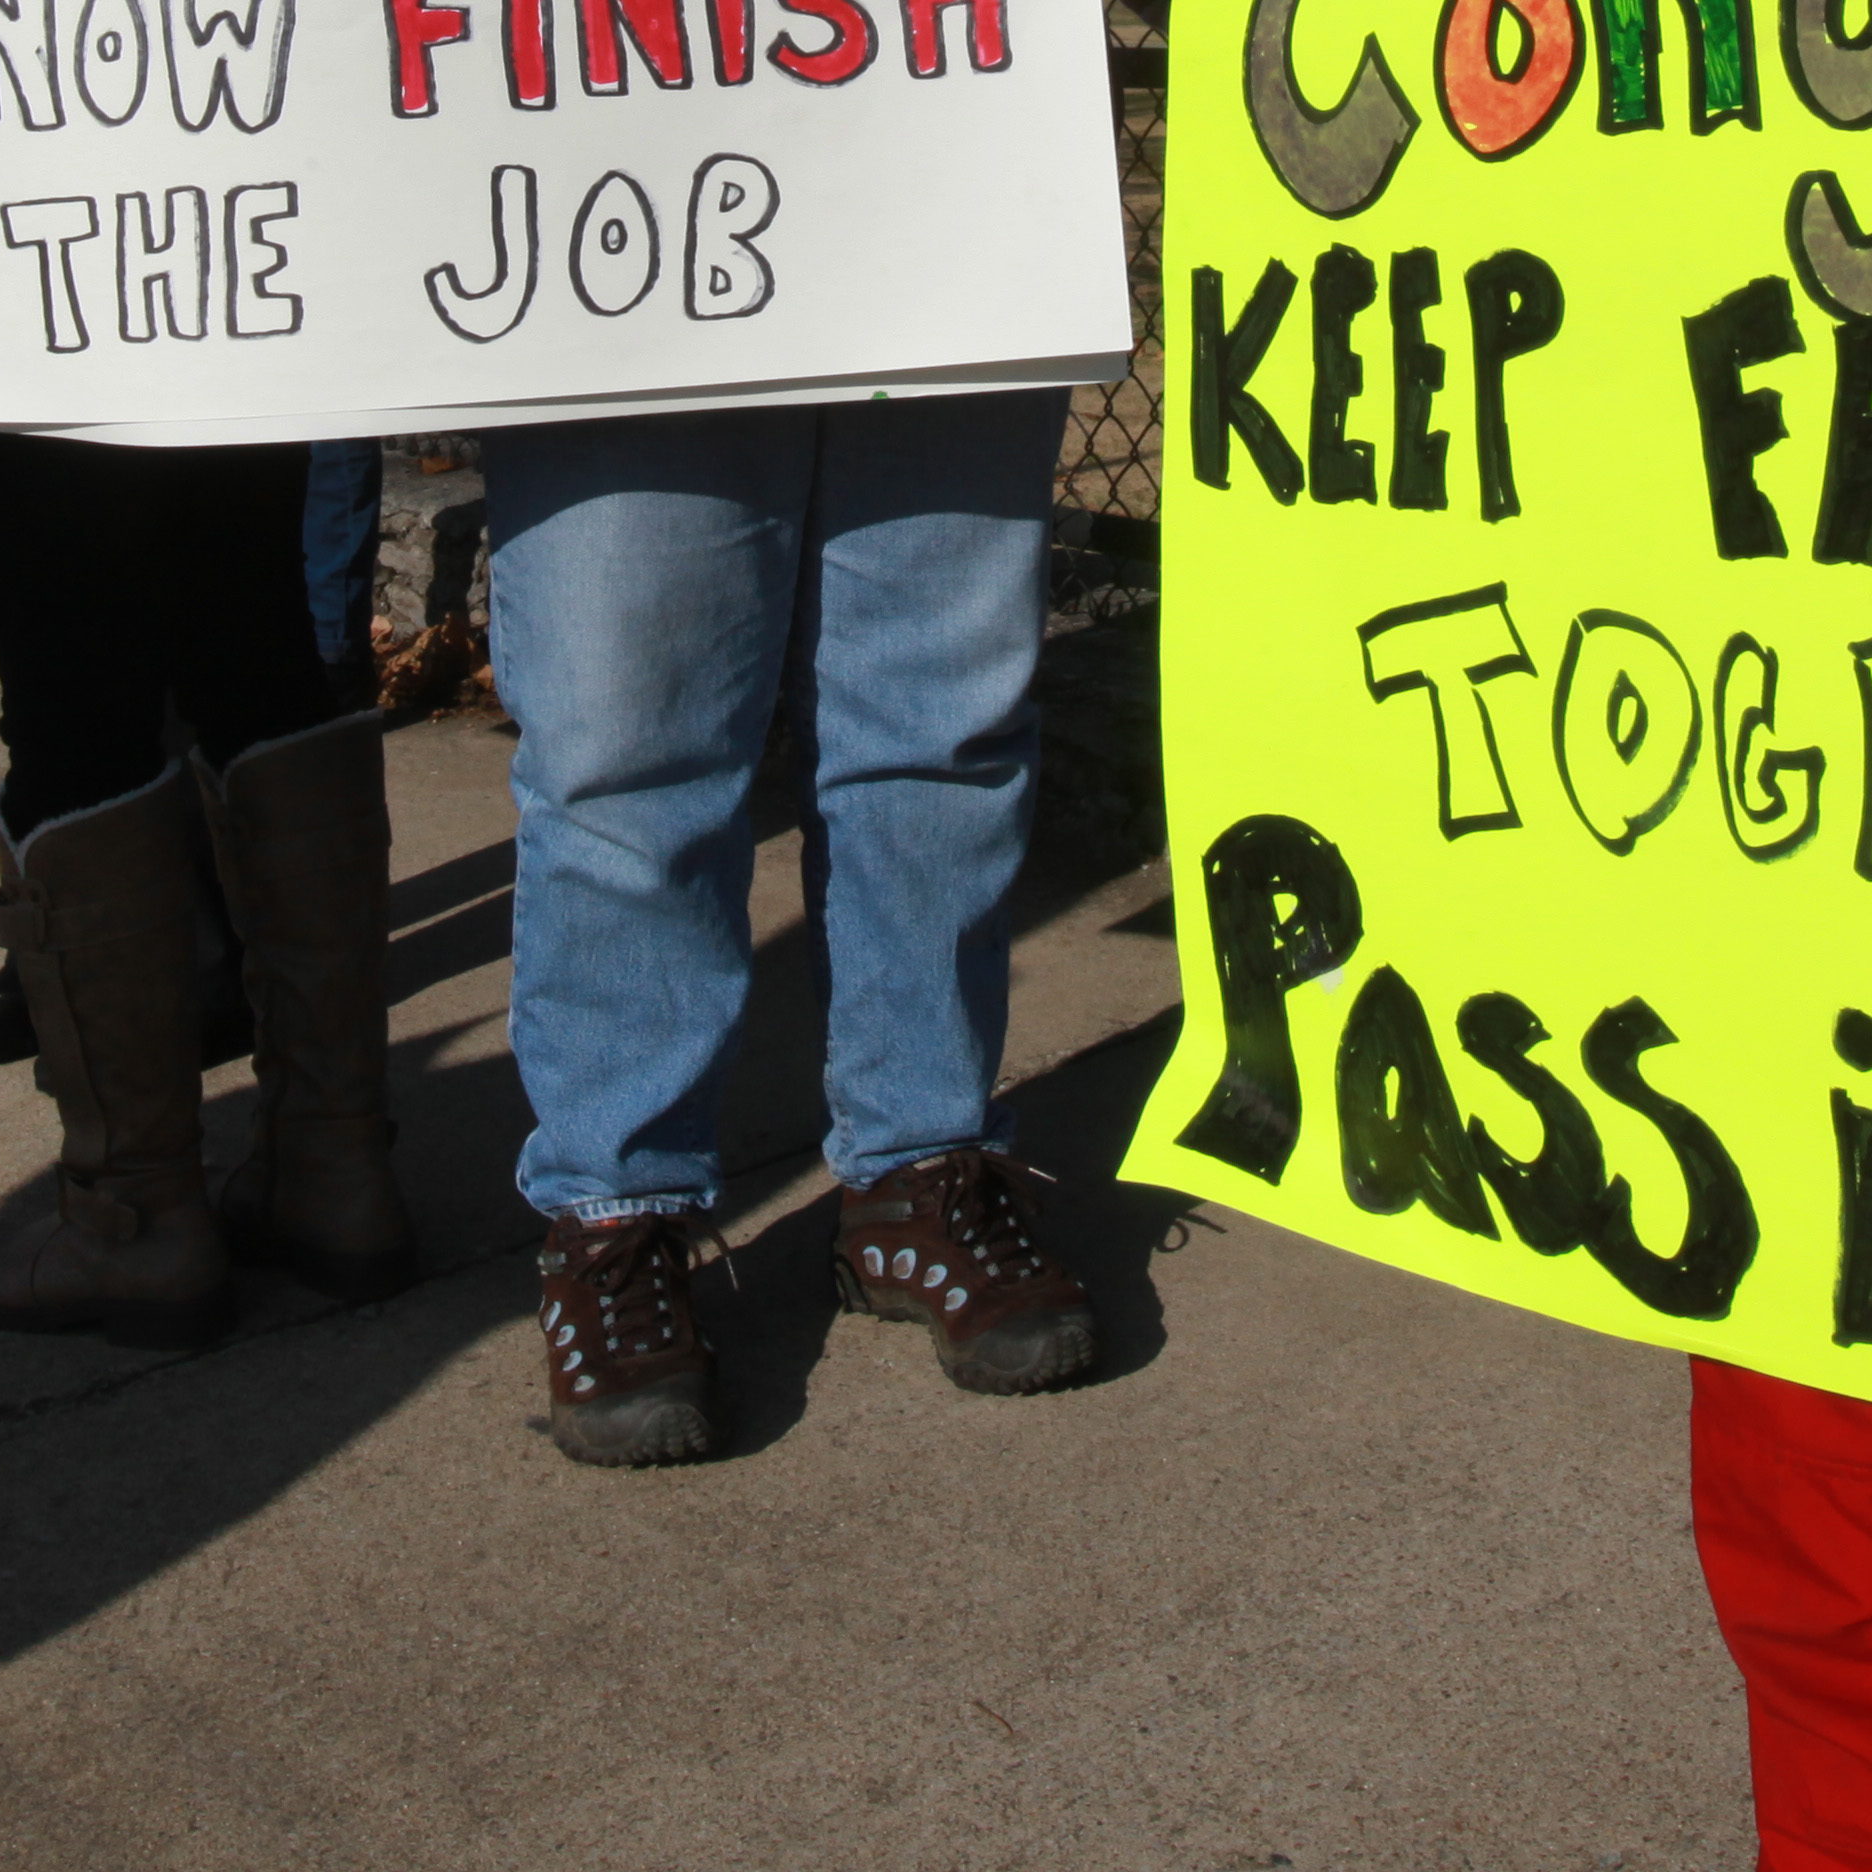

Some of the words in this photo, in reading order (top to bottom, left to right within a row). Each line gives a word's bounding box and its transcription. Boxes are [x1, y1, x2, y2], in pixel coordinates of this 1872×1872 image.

[0, 181, 303, 354] THE
[424, 153, 780, 343] JOB
[1190, 243, 1565, 523] KEEP
